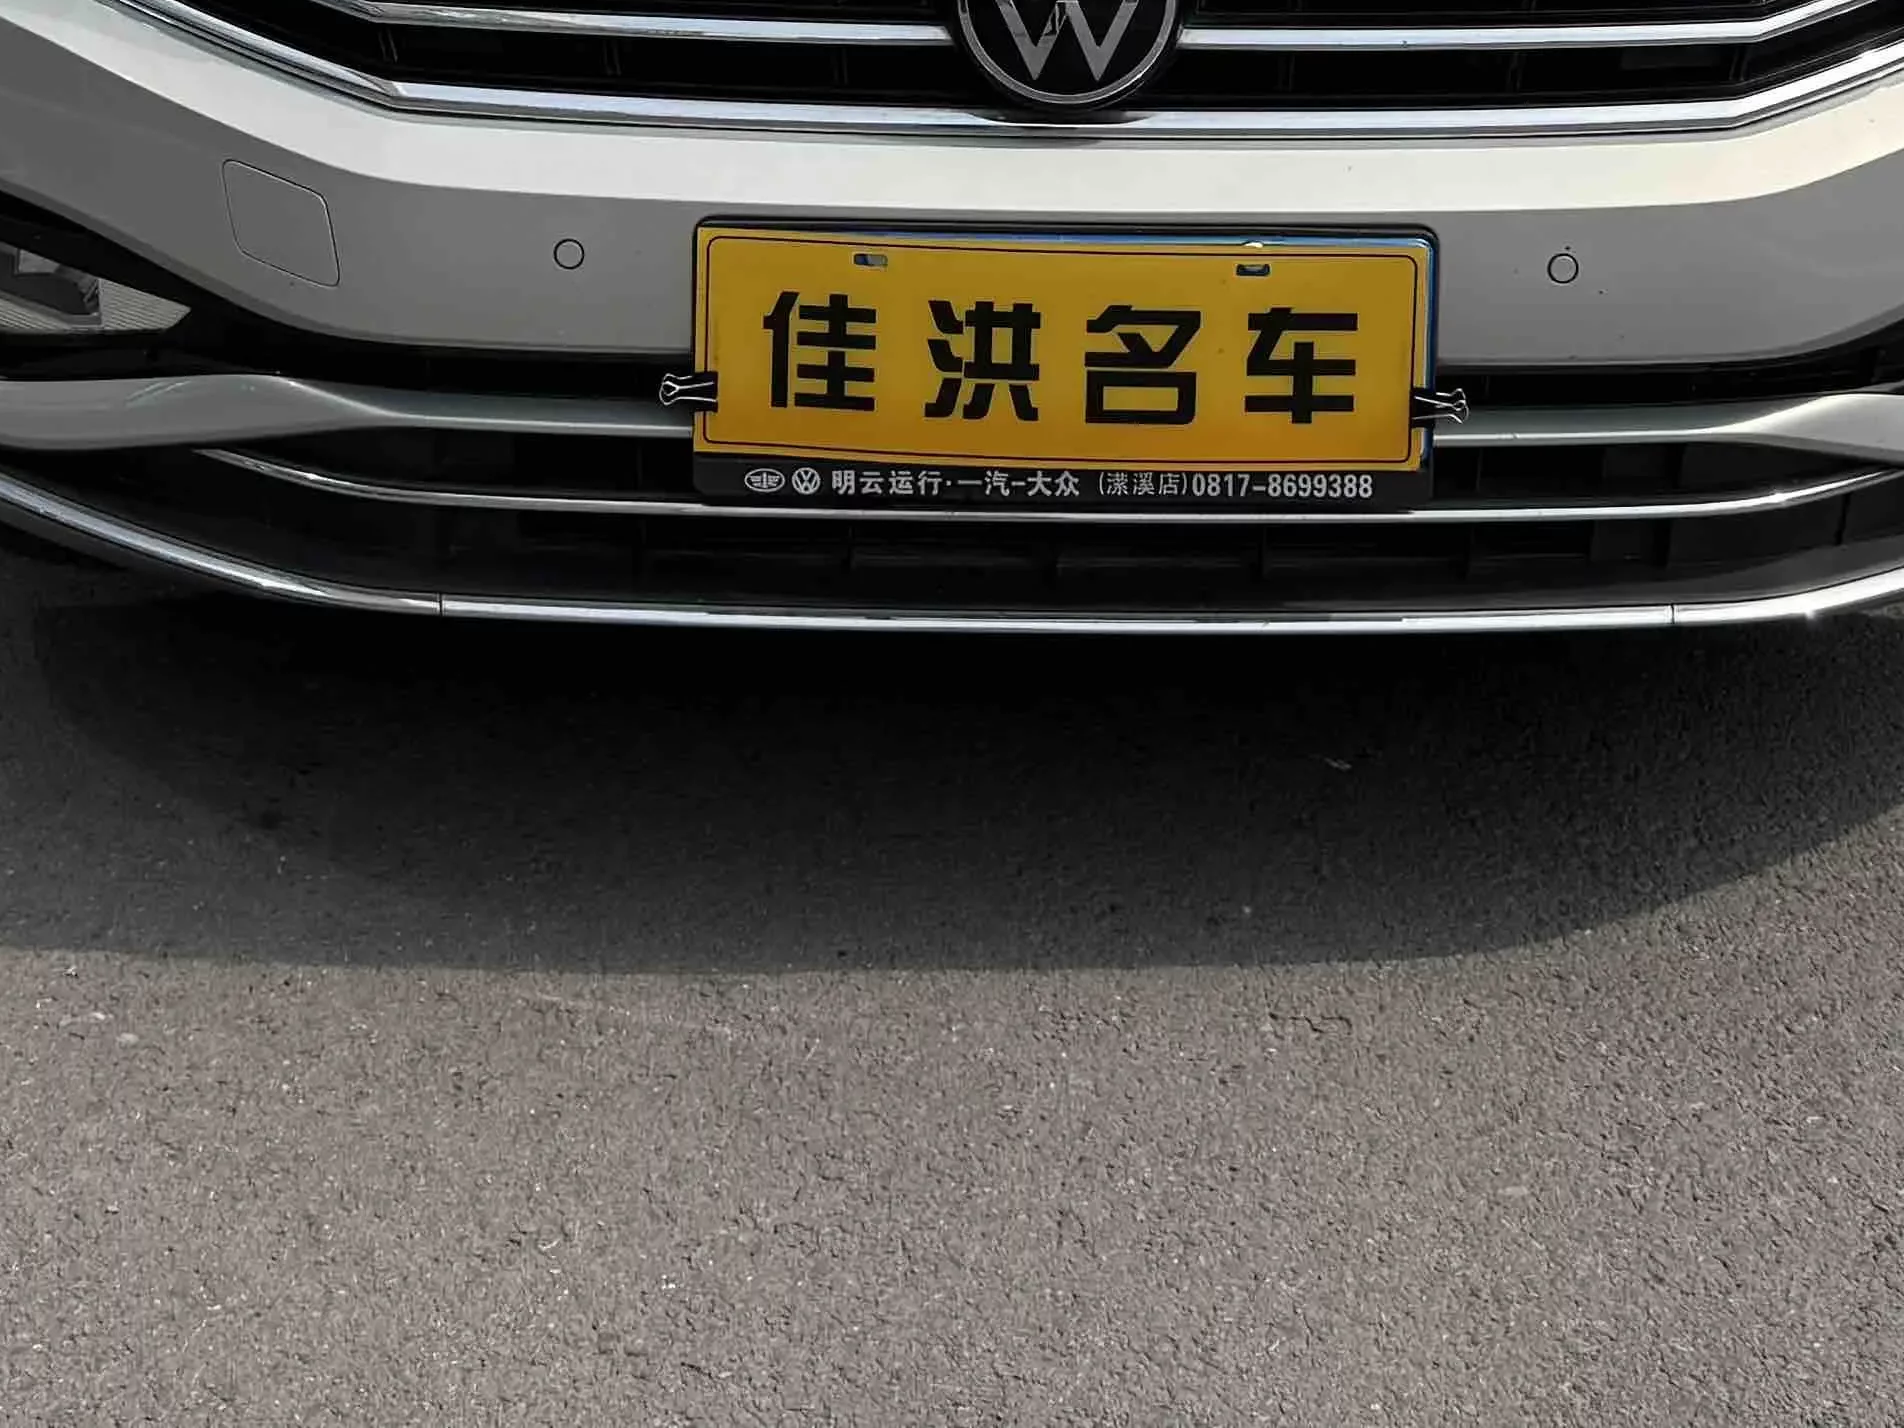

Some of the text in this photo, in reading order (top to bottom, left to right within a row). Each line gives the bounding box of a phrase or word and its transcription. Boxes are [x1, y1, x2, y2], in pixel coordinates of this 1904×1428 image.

[762, 290, 1358, 425] 佳洪名车
[1192, 473, 1373, 498] 0817-8699388
